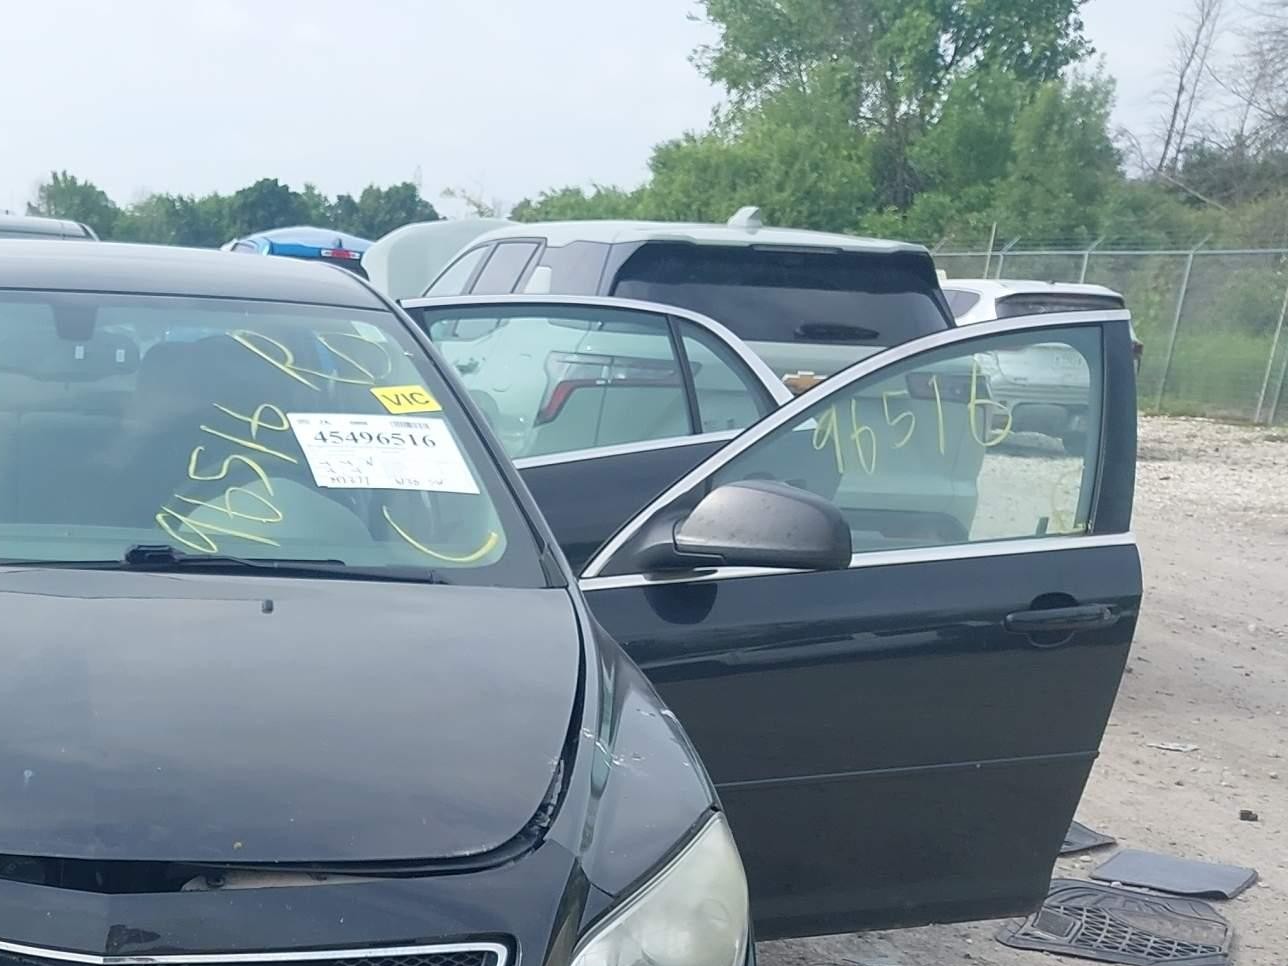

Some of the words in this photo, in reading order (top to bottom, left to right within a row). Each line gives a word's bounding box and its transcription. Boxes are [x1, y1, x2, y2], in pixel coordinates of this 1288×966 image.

[381, 391, 430, 408] VIC
[812, 352, 1013, 475] 96516
[313, 430, 437, 449] 45496516
[155, 402, 298, 553] 96516
